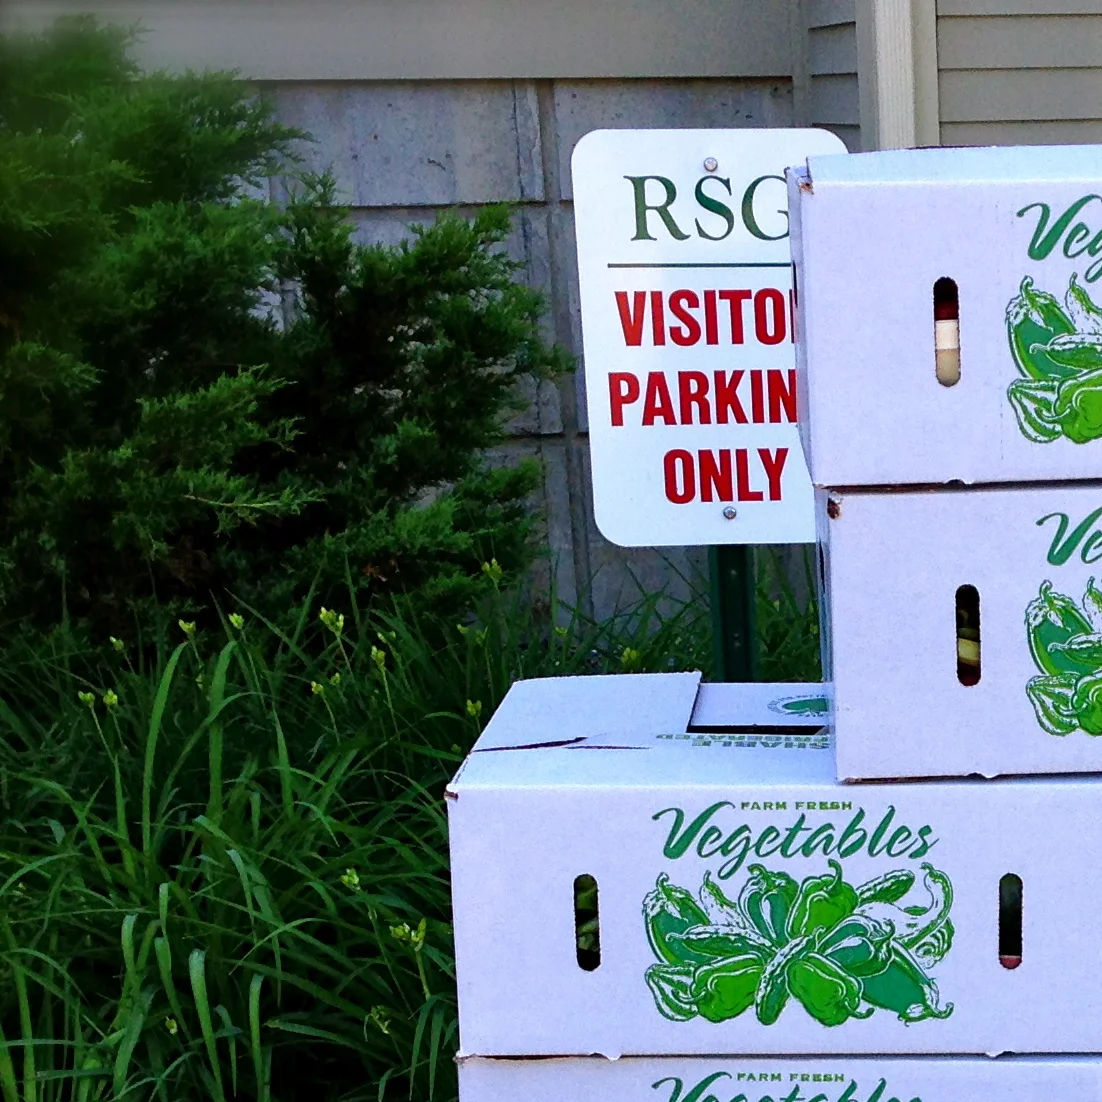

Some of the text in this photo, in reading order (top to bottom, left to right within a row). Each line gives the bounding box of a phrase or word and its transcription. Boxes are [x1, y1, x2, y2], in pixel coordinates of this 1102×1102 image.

[623, 174, 790, 241] RSG
[614, 288, 796, 347] VISITO
[608, 369, 798, 427] PARKIN
[663, 447, 789, 504] ONLY
[740, 801, 852, 811] FARM FRESH
[652, 801, 940, 880] Vegetables
[736, 1072, 845, 1082] FARM FRESH
